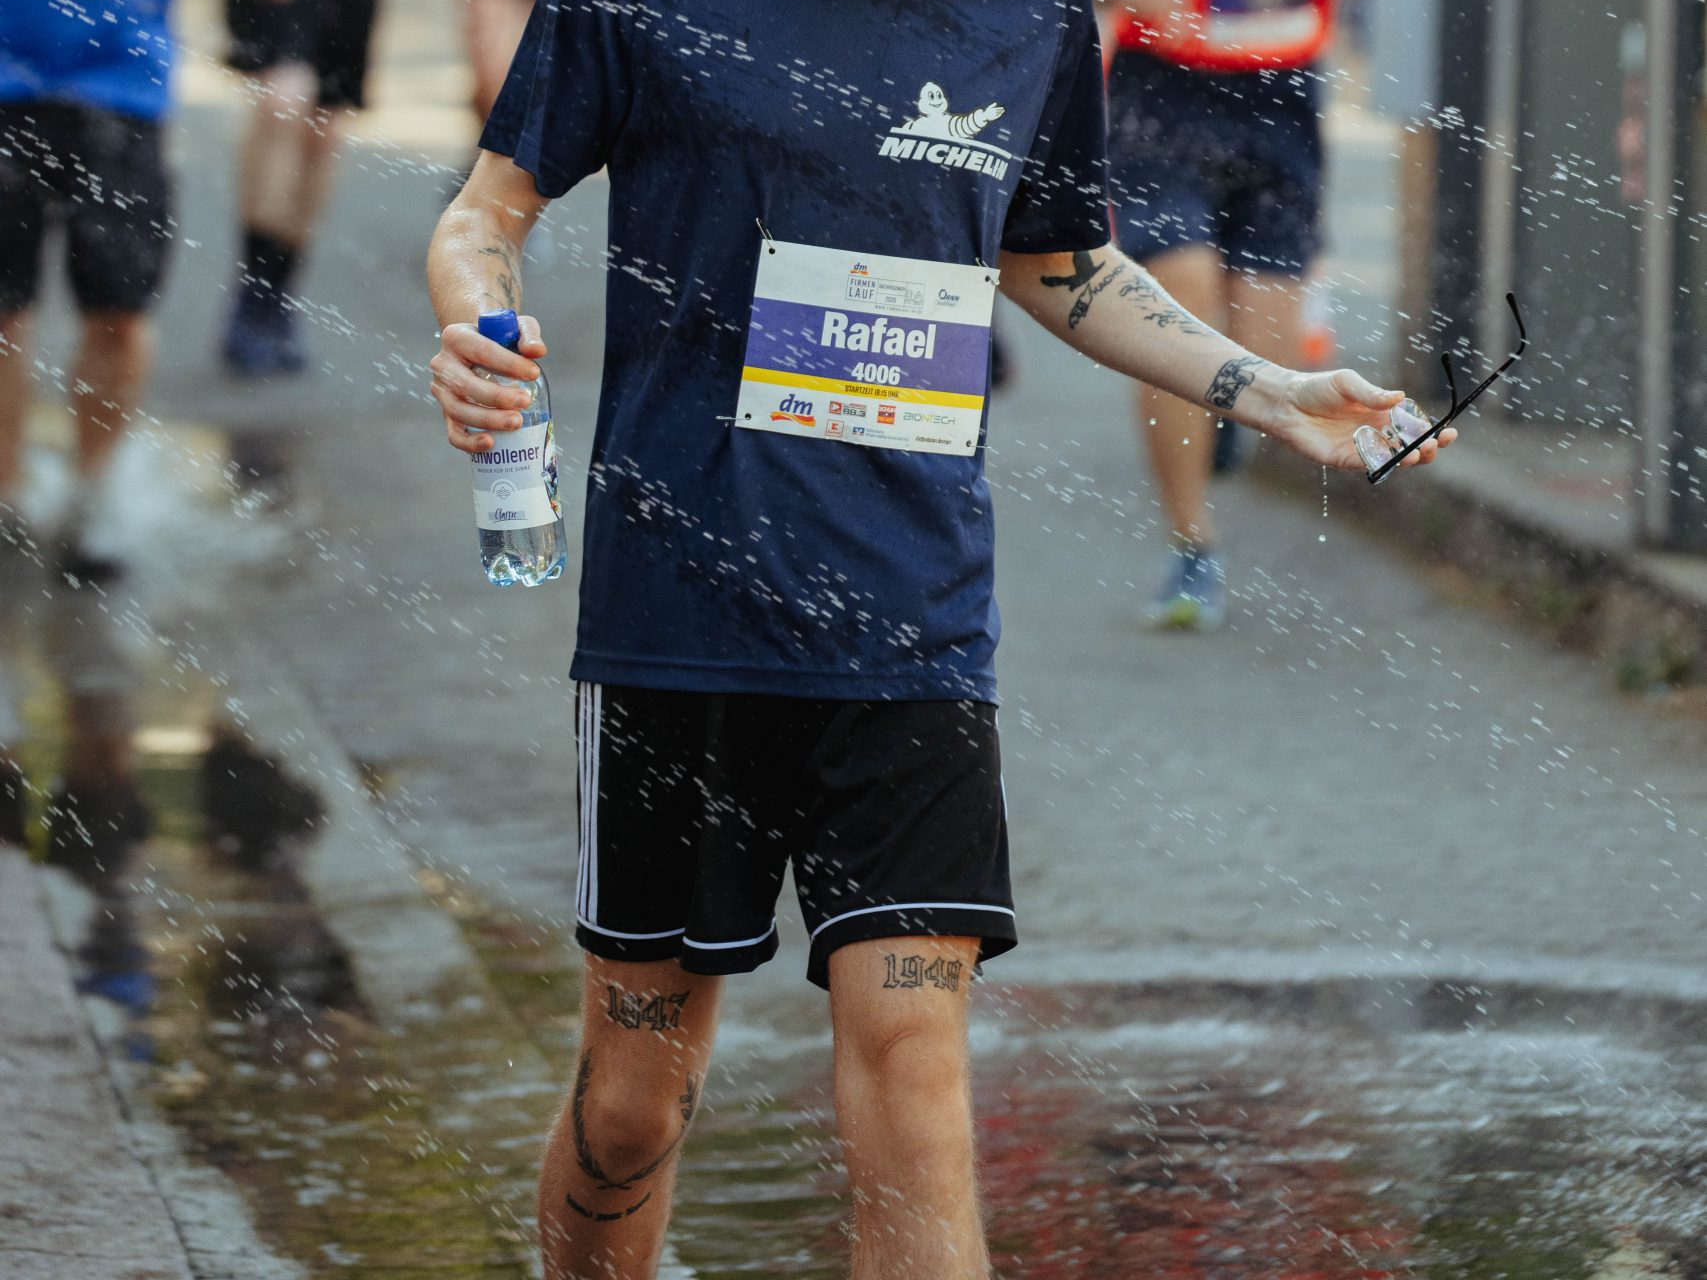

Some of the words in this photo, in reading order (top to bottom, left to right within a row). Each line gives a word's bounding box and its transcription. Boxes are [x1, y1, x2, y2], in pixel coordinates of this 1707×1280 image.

[878, 137, 1008, 181] MICHELIN
[853, 262, 868, 271] dm
[850, 279, 876, 288] FIRMEN
[848, 288, 875, 300] LAUF
[820, 311, 937, 359] Rafael
[851, 362, 901, 385] 4006
[845, 385, 873, 395] STARTZEIT
[779, 394, 813, 415] dm
[843, 408, 866, 418] 88.3
[903, 412, 956, 425] BIONTECH
[883, 953, 963, 992] 1948
